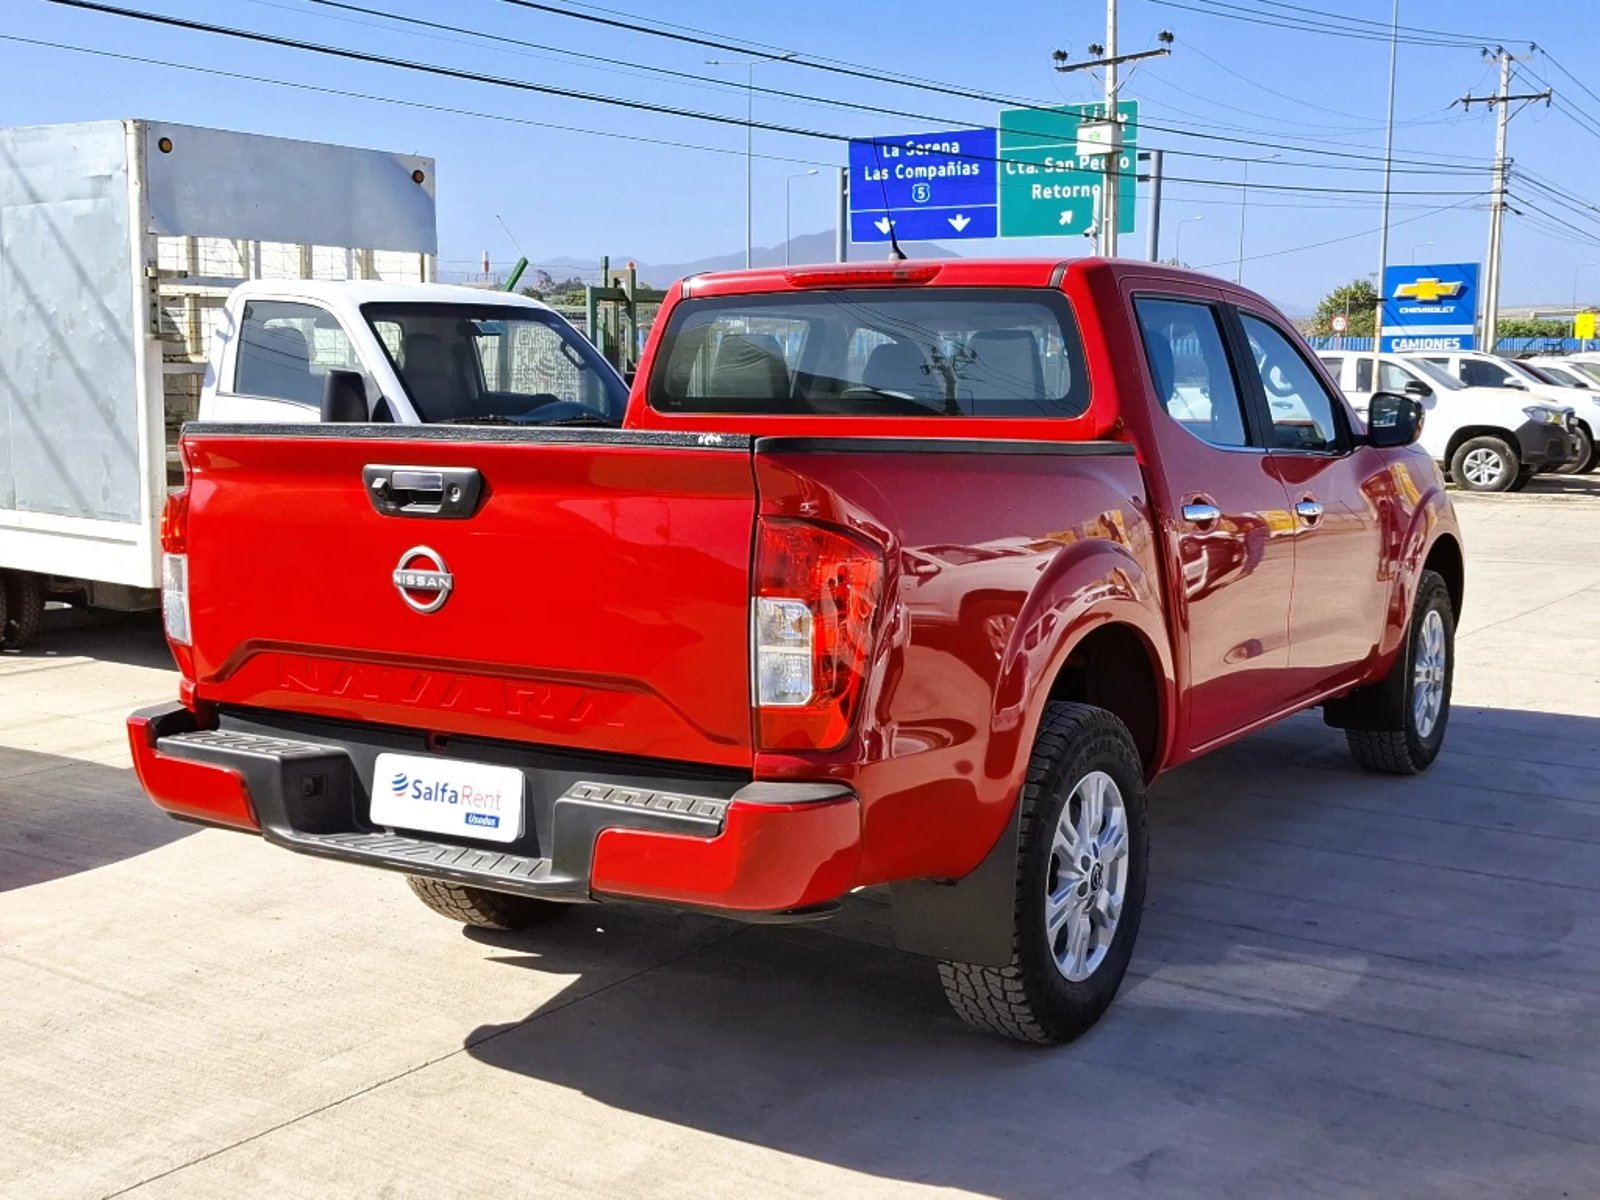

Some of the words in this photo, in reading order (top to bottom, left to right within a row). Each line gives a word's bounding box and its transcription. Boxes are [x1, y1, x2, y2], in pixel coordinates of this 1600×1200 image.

[883, 144, 899, 158] La
[906, 140, 960, 155] Serena
[864, 165, 889, 181] Las
[895, 160, 979, 179] Compañías
[1006, 159, 1038, 175] Cta.
[1044, 157, 1074, 173] San
[916, 186, 927, 199] 5
[1031, 184, 1101, 199] Retorno
[1399, 306, 1456, 314] CHEVROLET
[1391, 337, 1460, 351] CAMIONES
[393, 573, 452, 589] NISSAN
[278, 655, 626, 728] NAVARA
[467, 814, 497, 827] Usados
